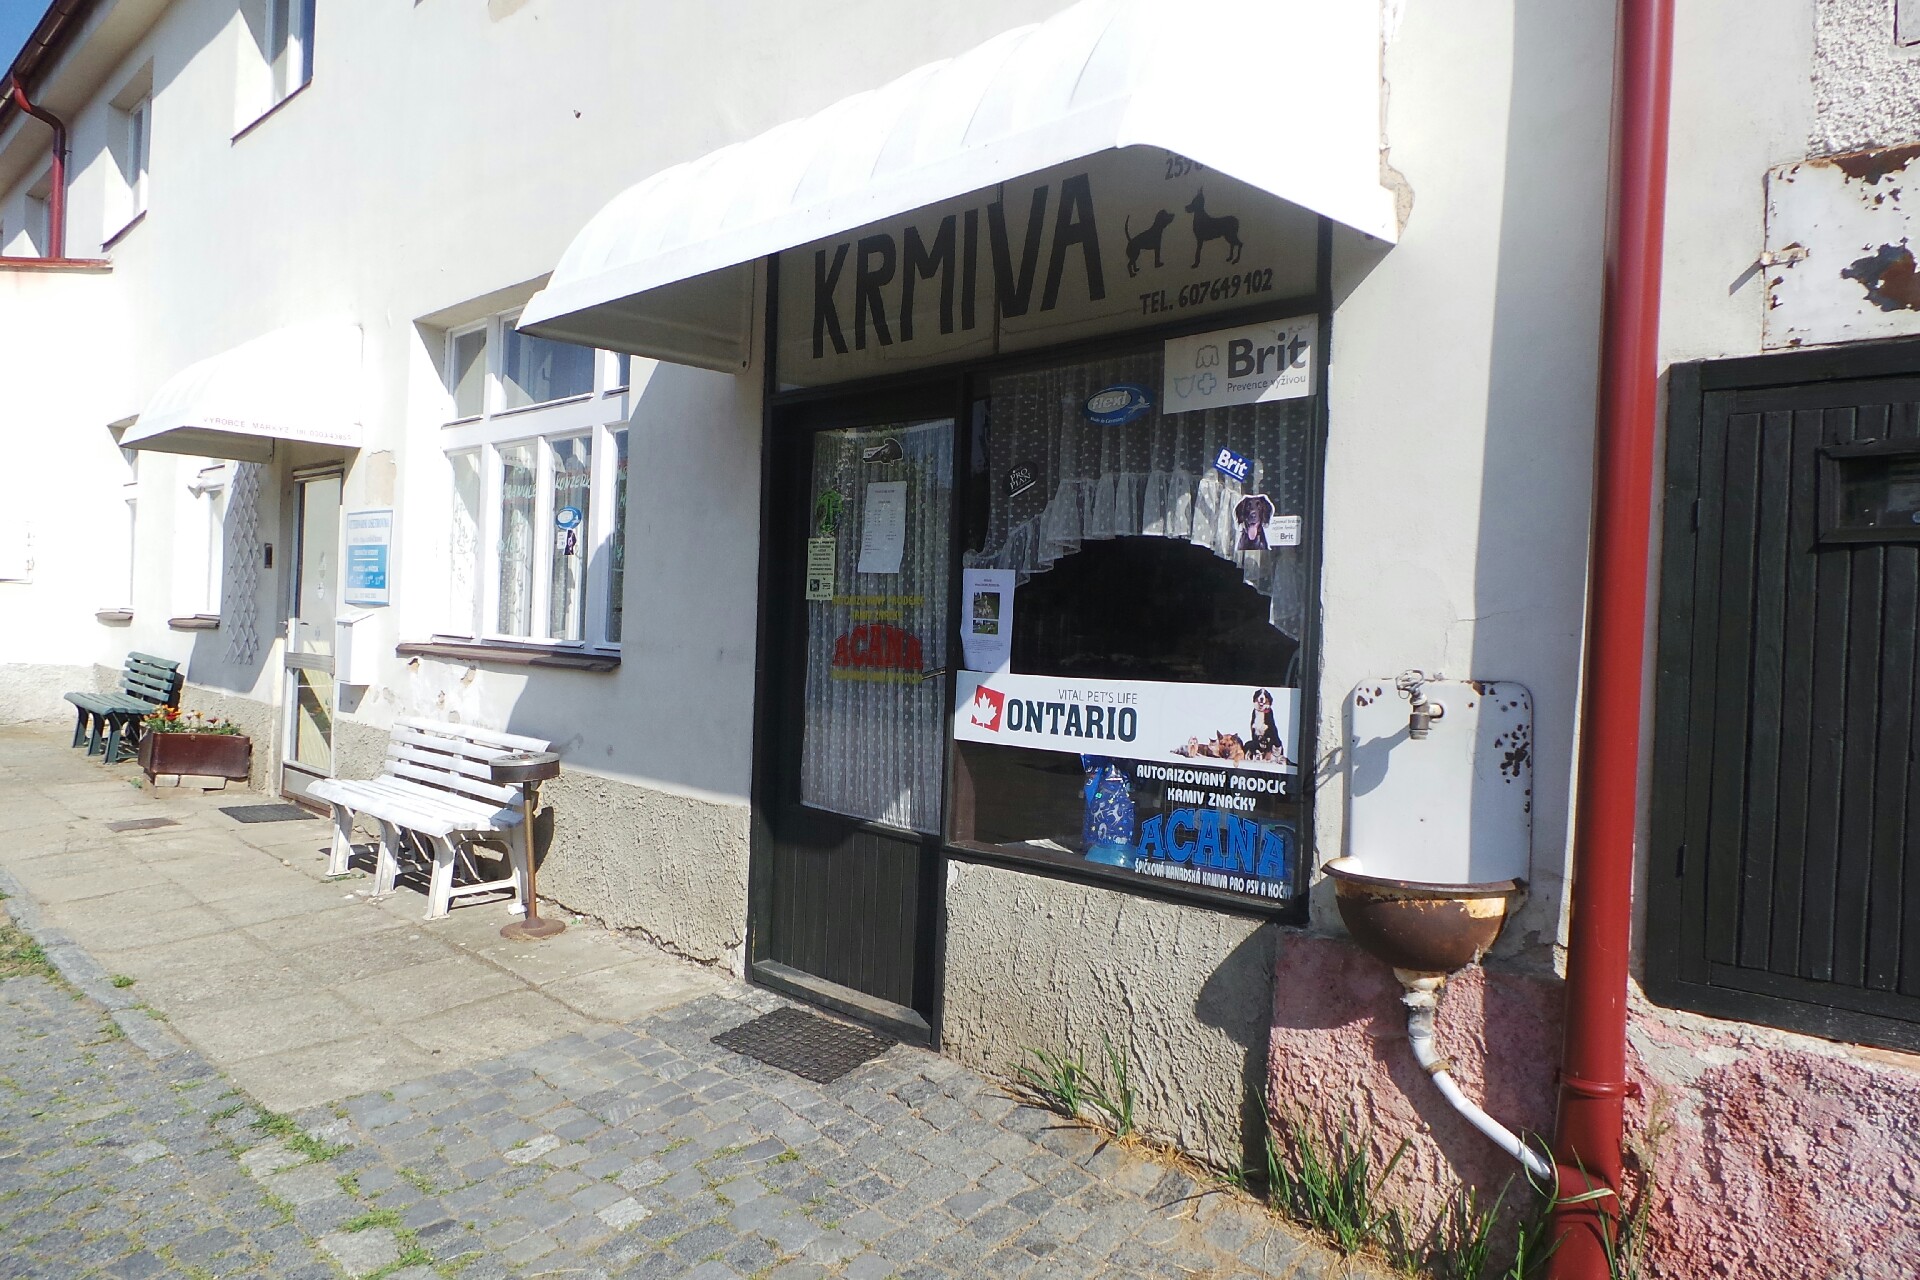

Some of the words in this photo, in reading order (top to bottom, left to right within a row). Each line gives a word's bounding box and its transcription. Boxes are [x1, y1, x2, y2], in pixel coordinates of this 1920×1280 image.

[812, 172, 1106, 359] KRMIVA
[1139, 290, 1173, 315] TEL.
[1228, 332, 1307, 379] Brit
[1227, 380, 1268, 393] Prevence
[1271, 374, 1306, 389] výživou
[1217, 448, 1248, 477] Brit
[832, 623, 923, 670] ACANA
[1058, 689, 1084, 701] VITAL
[1087, 691, 1114, 703] PET'S
[1117, 693, 1138, 704] LIFE
[1007, 698, 1137, 742] ONTARIO
[1137, 764, 1227, 788] AUTORIZOVANÝ
[1208, 793, 1257, 811] ZNAČKY
[1136, 808, 1285, 877] ACANA
[1229, 876, 1245, 892] PRO
[1246, 879, 1259, 895] PSY
[1260, 881, 1267, 896] A
